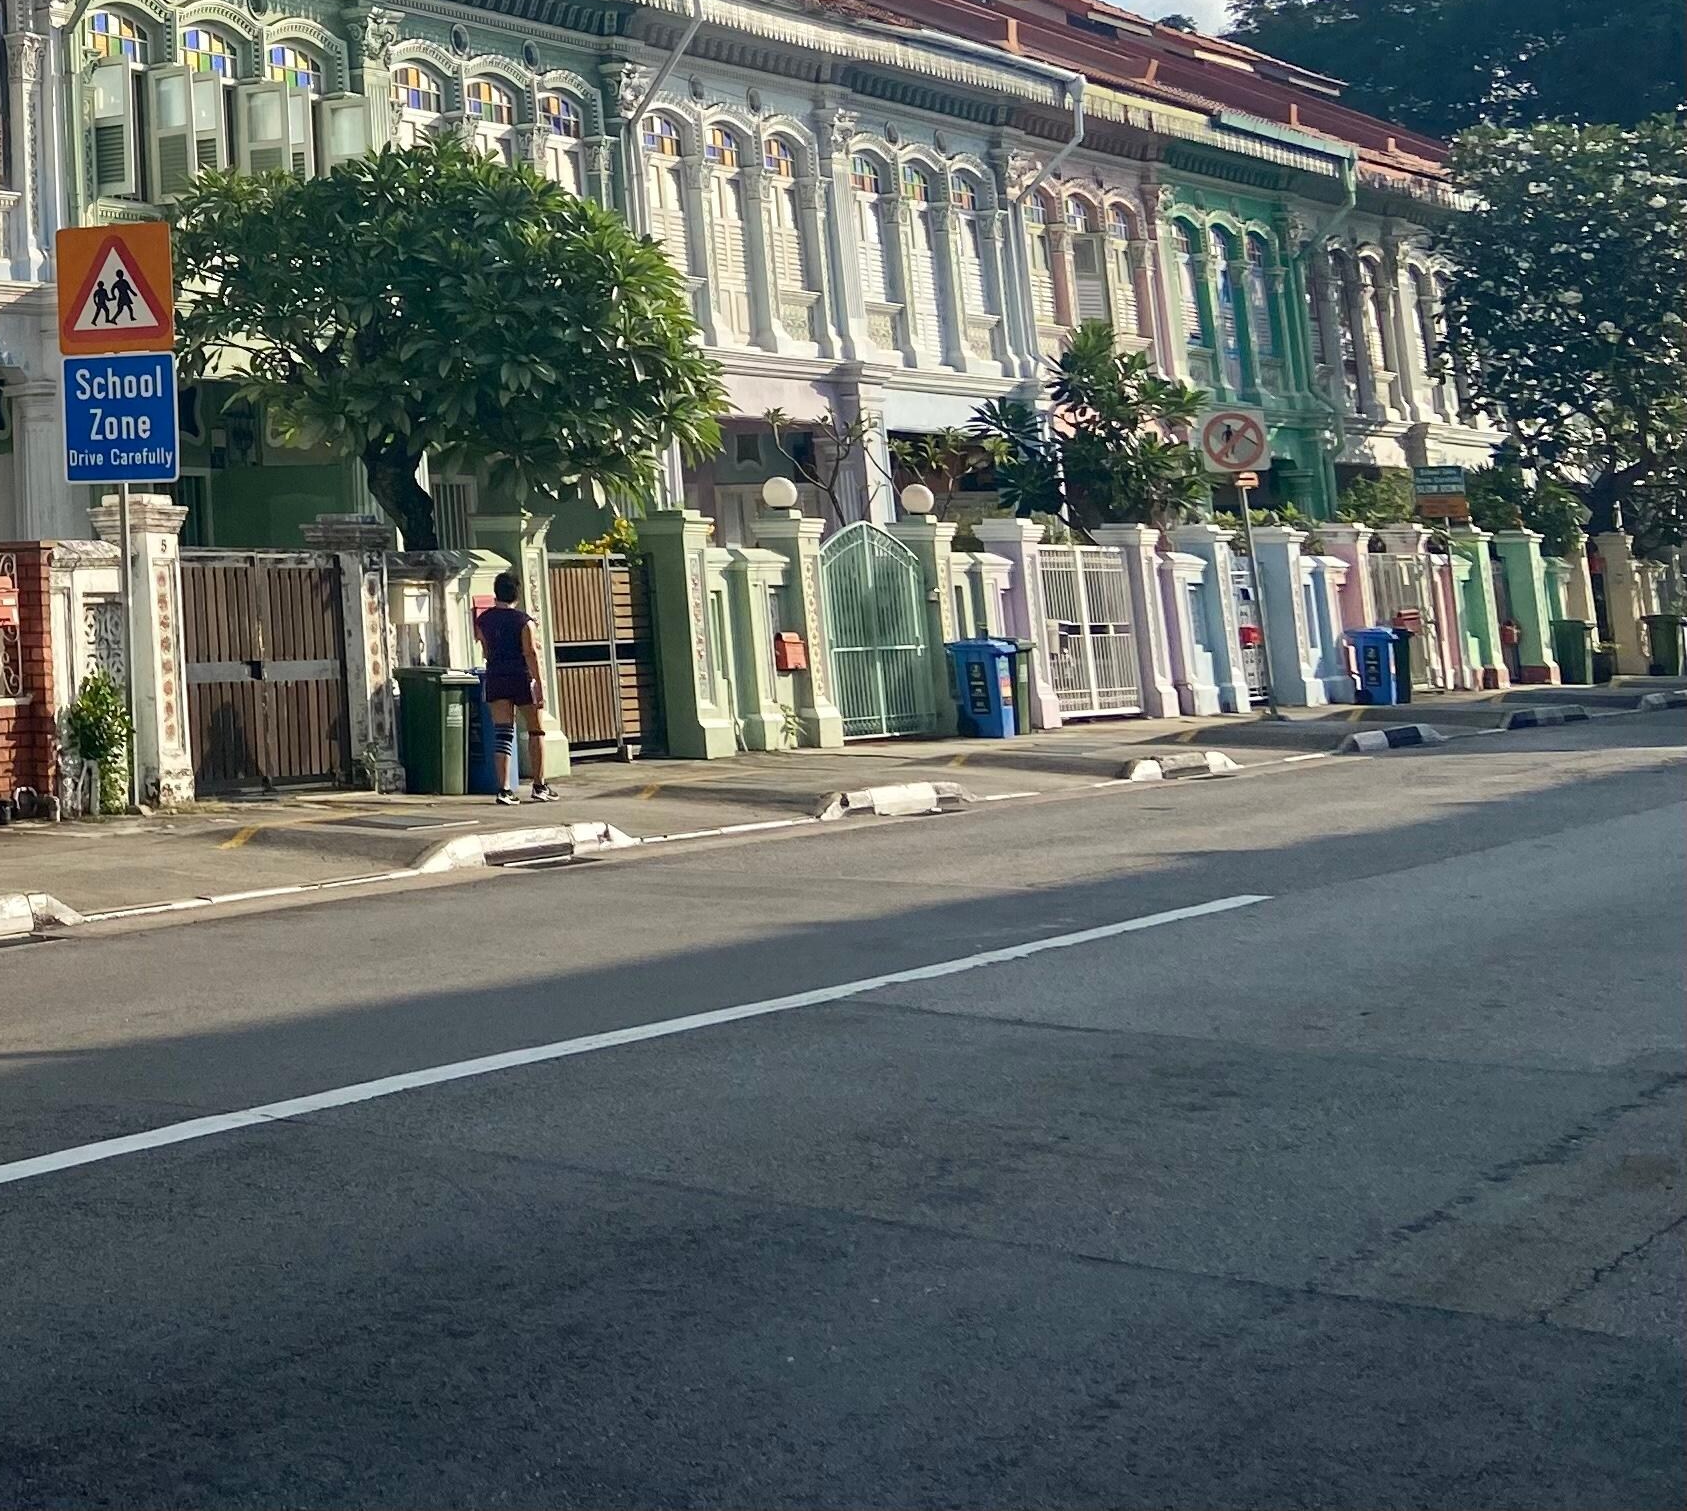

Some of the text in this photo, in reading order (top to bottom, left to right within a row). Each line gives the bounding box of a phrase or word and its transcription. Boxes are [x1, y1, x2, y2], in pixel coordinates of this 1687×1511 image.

[75, 365, 162, 400] School
[89, 408, 151, 441] Zone
[69, 447, 173, 468] Drive Carefully
[160, 538, 167, 553] 5
